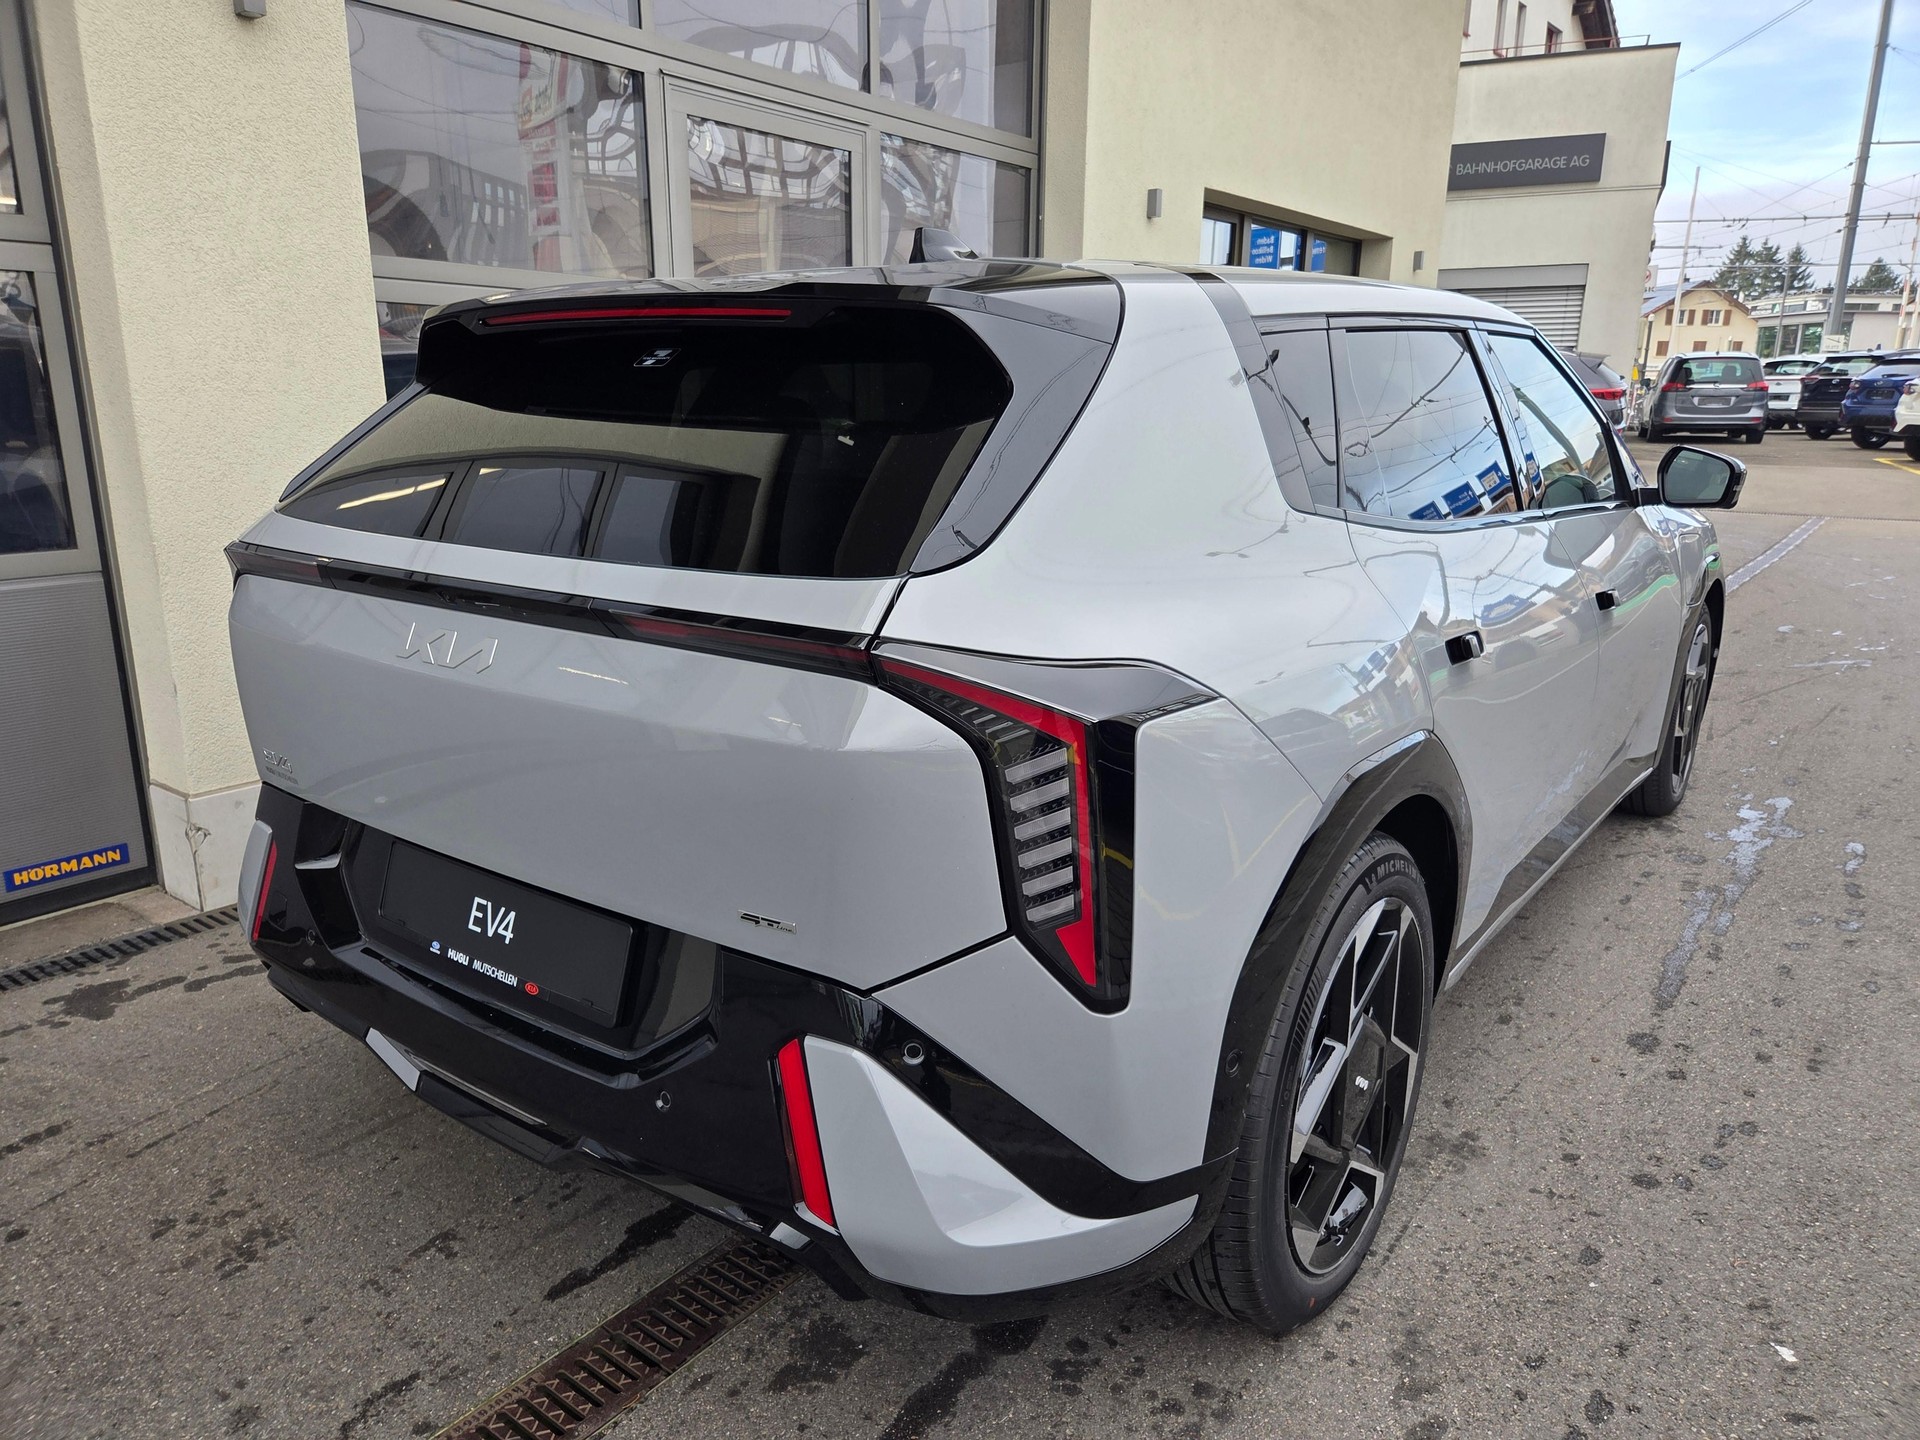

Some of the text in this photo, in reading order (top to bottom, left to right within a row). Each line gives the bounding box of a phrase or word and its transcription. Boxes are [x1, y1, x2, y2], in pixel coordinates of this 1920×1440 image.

[1456, 154, 1590, 175] BAHNHOFGARAGE AG
[13, 848, 121, 886] HÖRMANN
[1376, 859, 1417, 880] MICHELIN
[468, 896, 516, 945] EV4
[472, 959, 518, 987] MUTSCHELLEN
